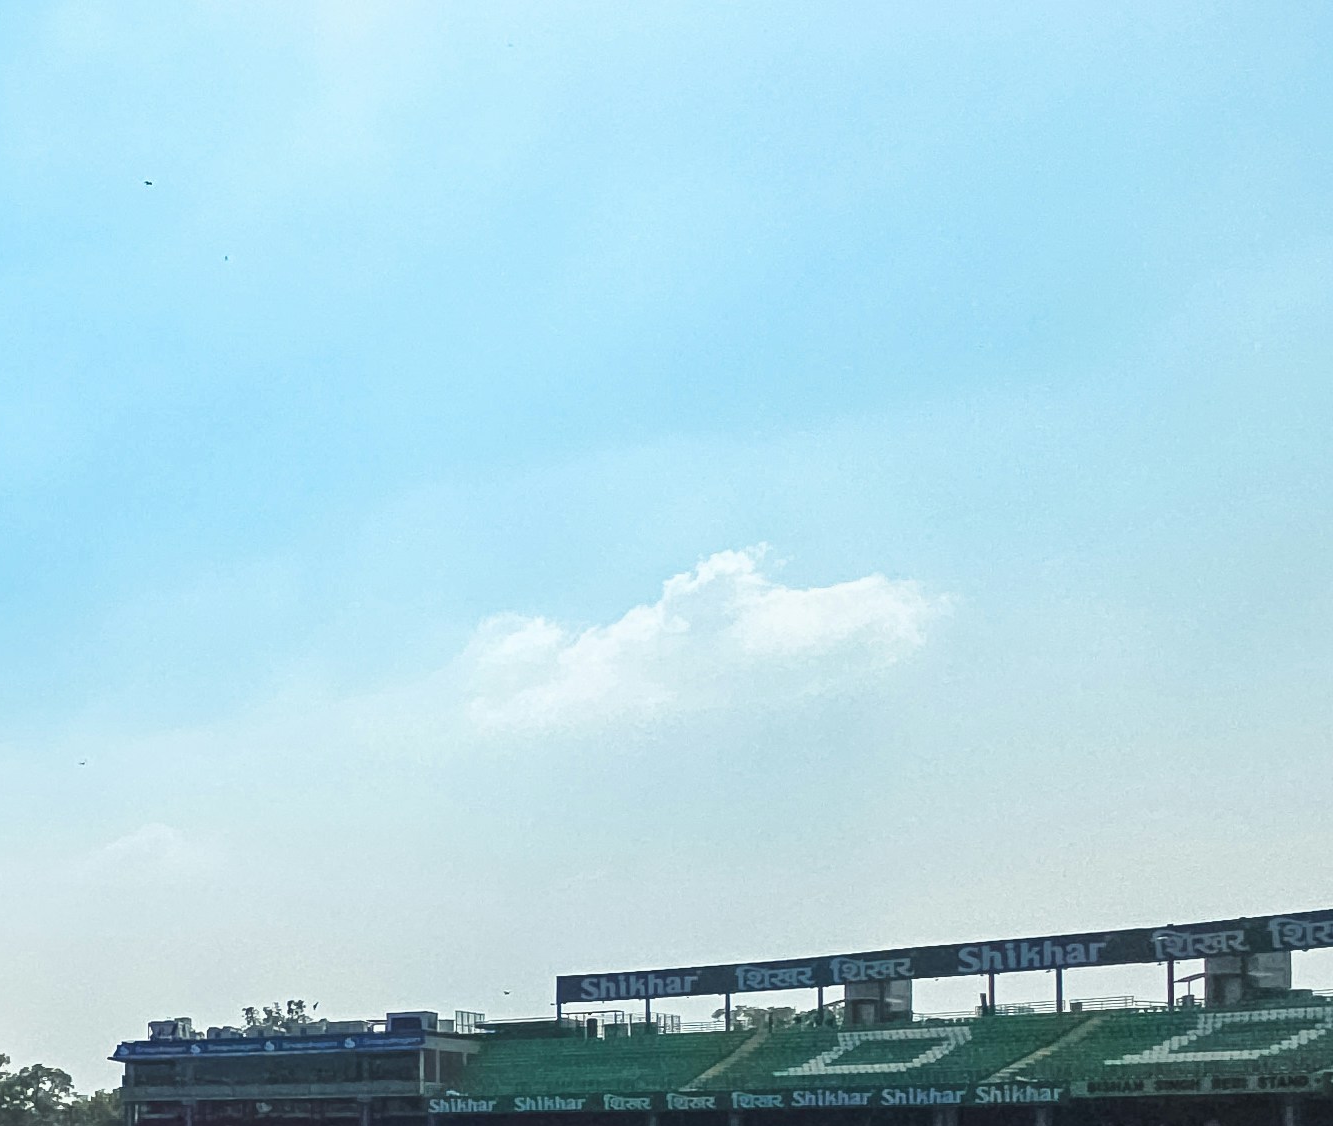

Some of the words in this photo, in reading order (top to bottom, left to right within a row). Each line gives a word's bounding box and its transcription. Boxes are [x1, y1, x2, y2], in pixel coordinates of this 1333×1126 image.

[957, 939, 1107, 974] Shikhar
[1152, 928, 1250, 960] शिखर
[580, 972, 699, 1001] Shikhar
[734, 964, 816, 991] शिखर
[830, 956, 915, 984] शिखर
[428, 1097, 497, 1112] Shikhar
[514, 1096, 586, 1111] Shikhar
[791, 1089, 873, 1107] Shikhar
[881, 1087, 967, 1106] Shikhar
[975, 1085, 1064, 1104] Shikhar
